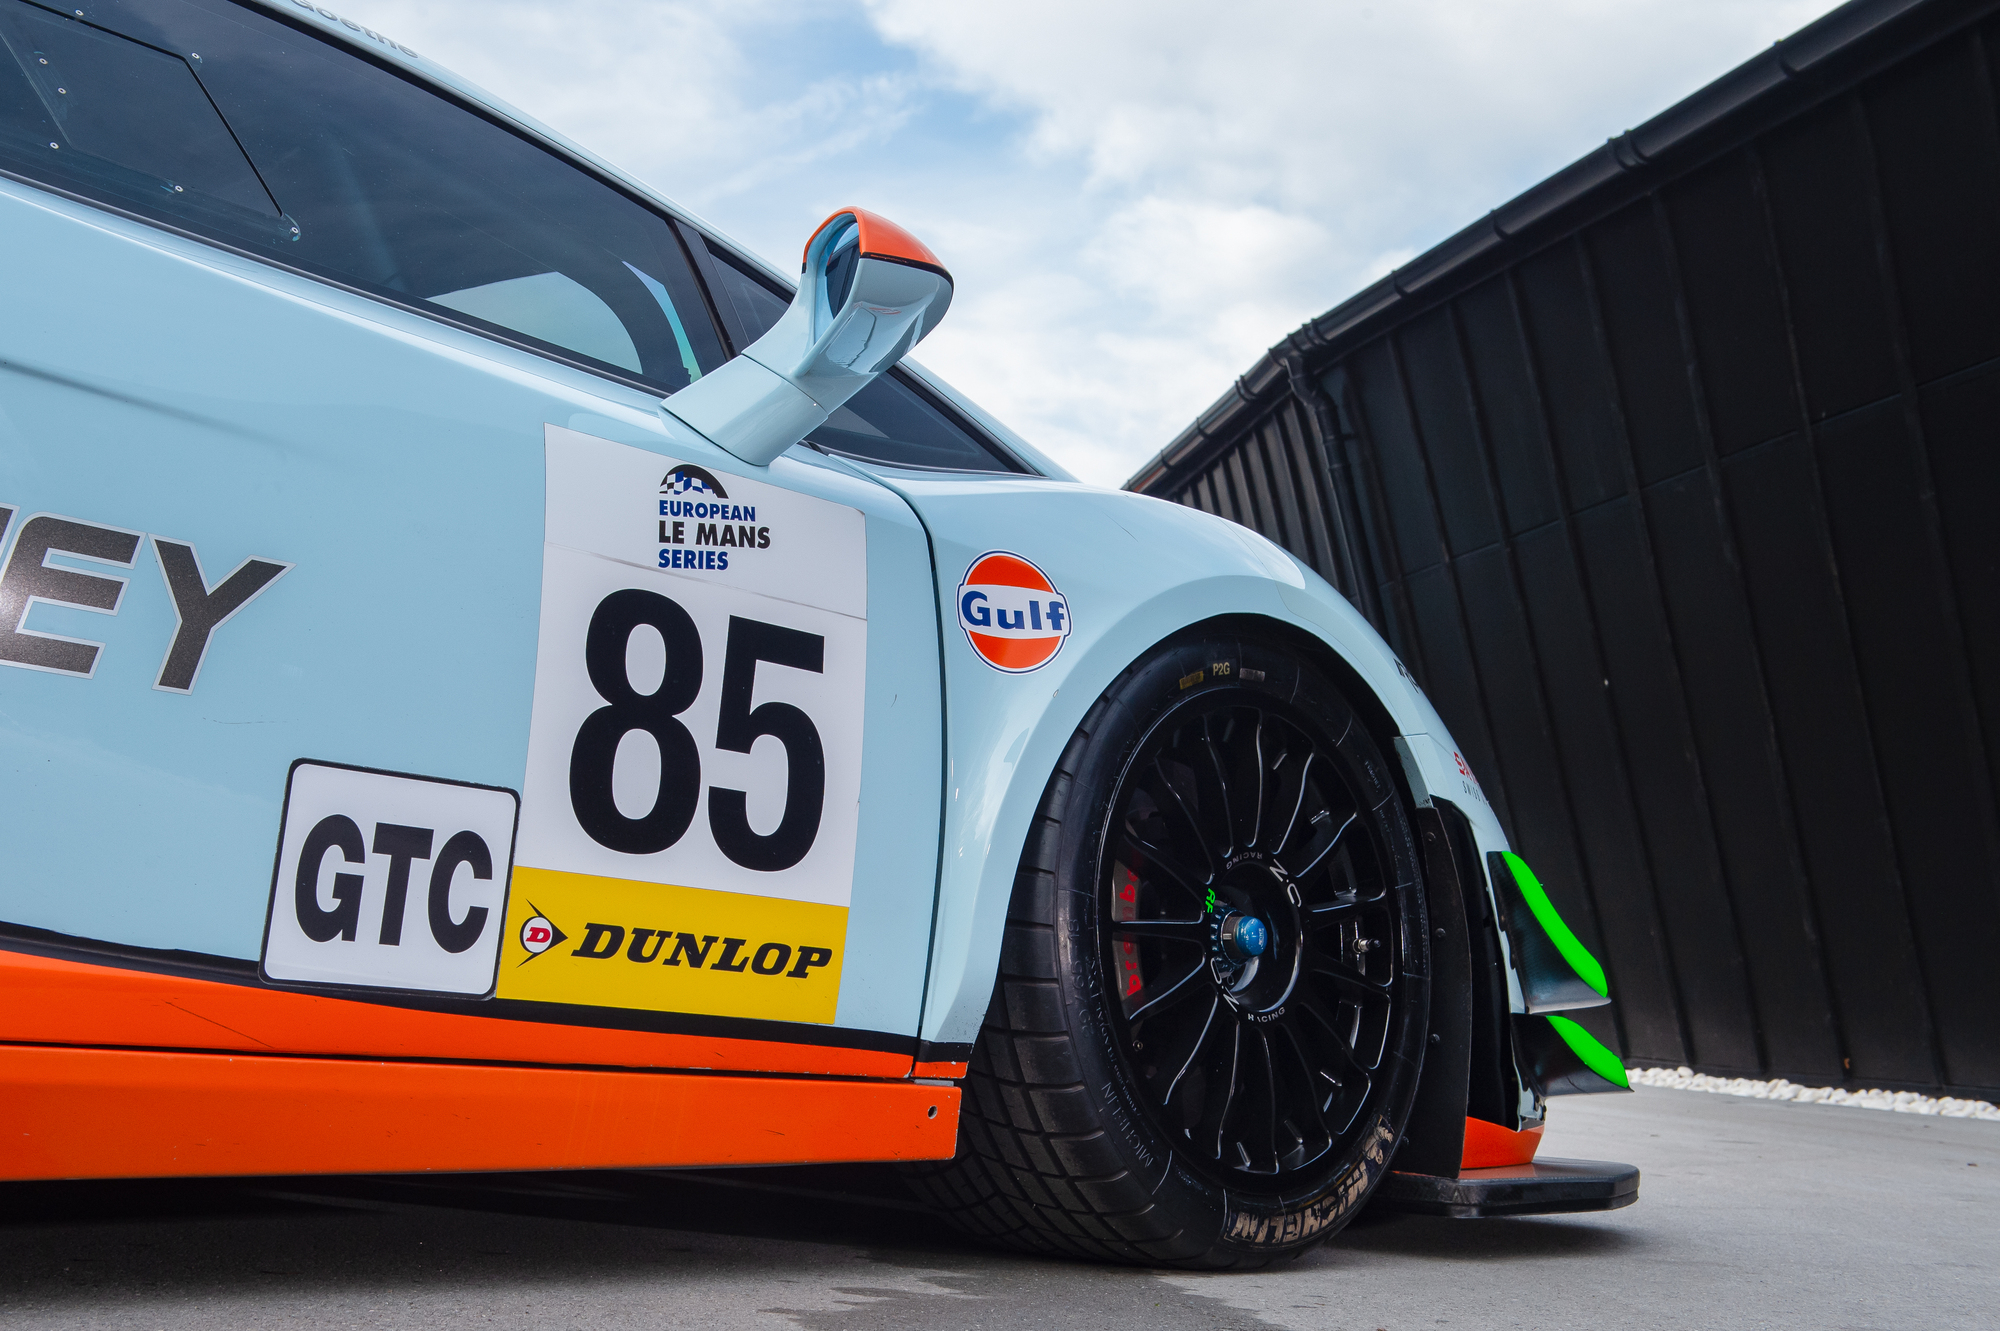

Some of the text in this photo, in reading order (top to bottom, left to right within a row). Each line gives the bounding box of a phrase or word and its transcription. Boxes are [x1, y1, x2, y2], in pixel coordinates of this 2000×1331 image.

[658, 520, 771, 549] LE MANS
[659, 499, 756, 522] EUROPEAN
[658, 548, 729, 571] SERIES
[0, 503, 293, 693] EY
[961, 590, 1065, 631] Gulf
[1212, 661, 1231, 676] P2G
[569, 588, 825, 872] 85
[295, 813, 493, 954] GTC
[1225, 850, 1264, 870] RACING
[525, 922, 833, 979] D DUNLOP
[1101, 1081, 1154, 1168] MICHELIN
[1230, 1160, 1369, 1244] MICHELIN
